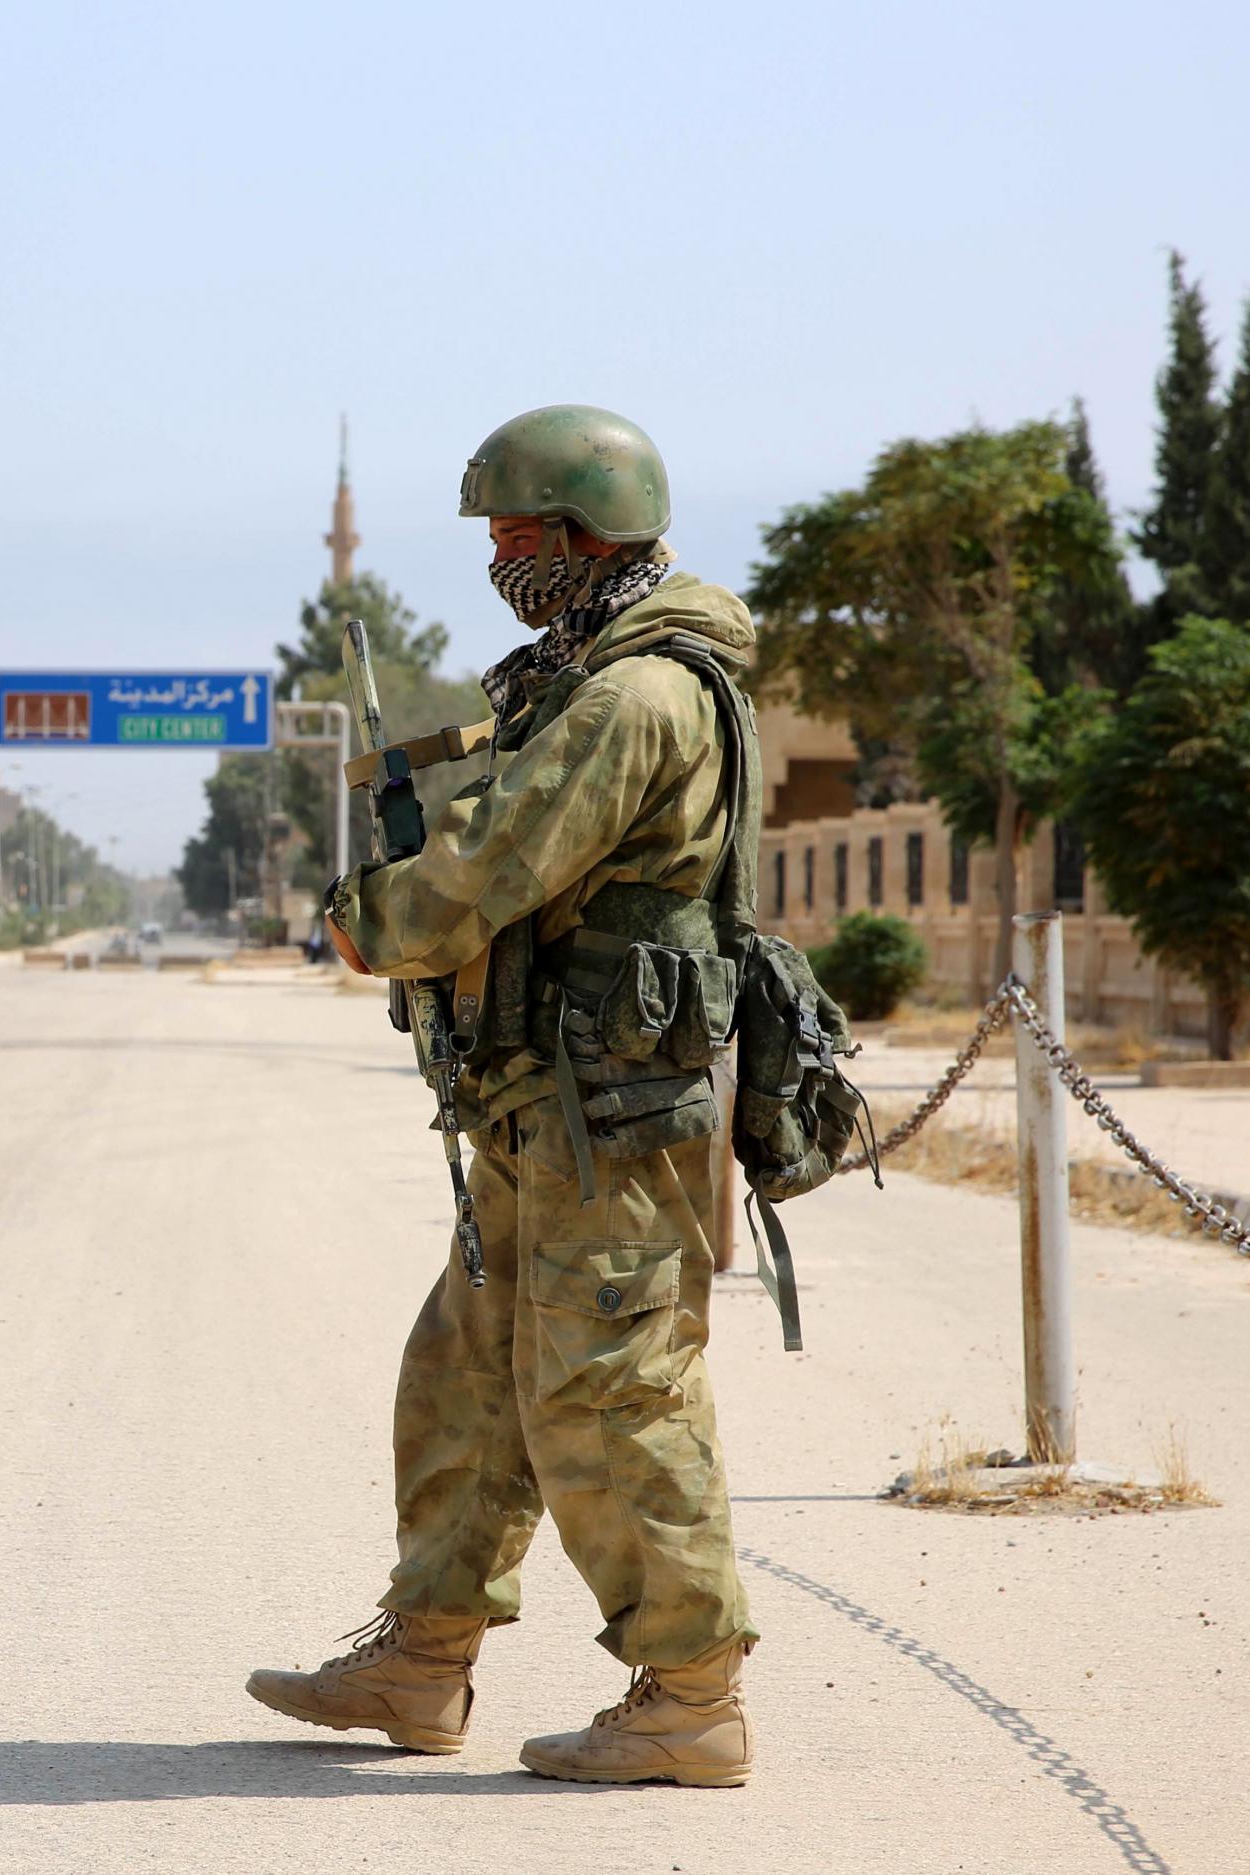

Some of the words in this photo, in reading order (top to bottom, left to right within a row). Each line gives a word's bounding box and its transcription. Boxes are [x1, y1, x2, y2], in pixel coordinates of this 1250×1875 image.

[108, 678, 186, 710] المدينة
[182, 679, 235, 710] مركز
[124, 717, 157, 738] CITY
[161, 717, 221, 738] CENTER
